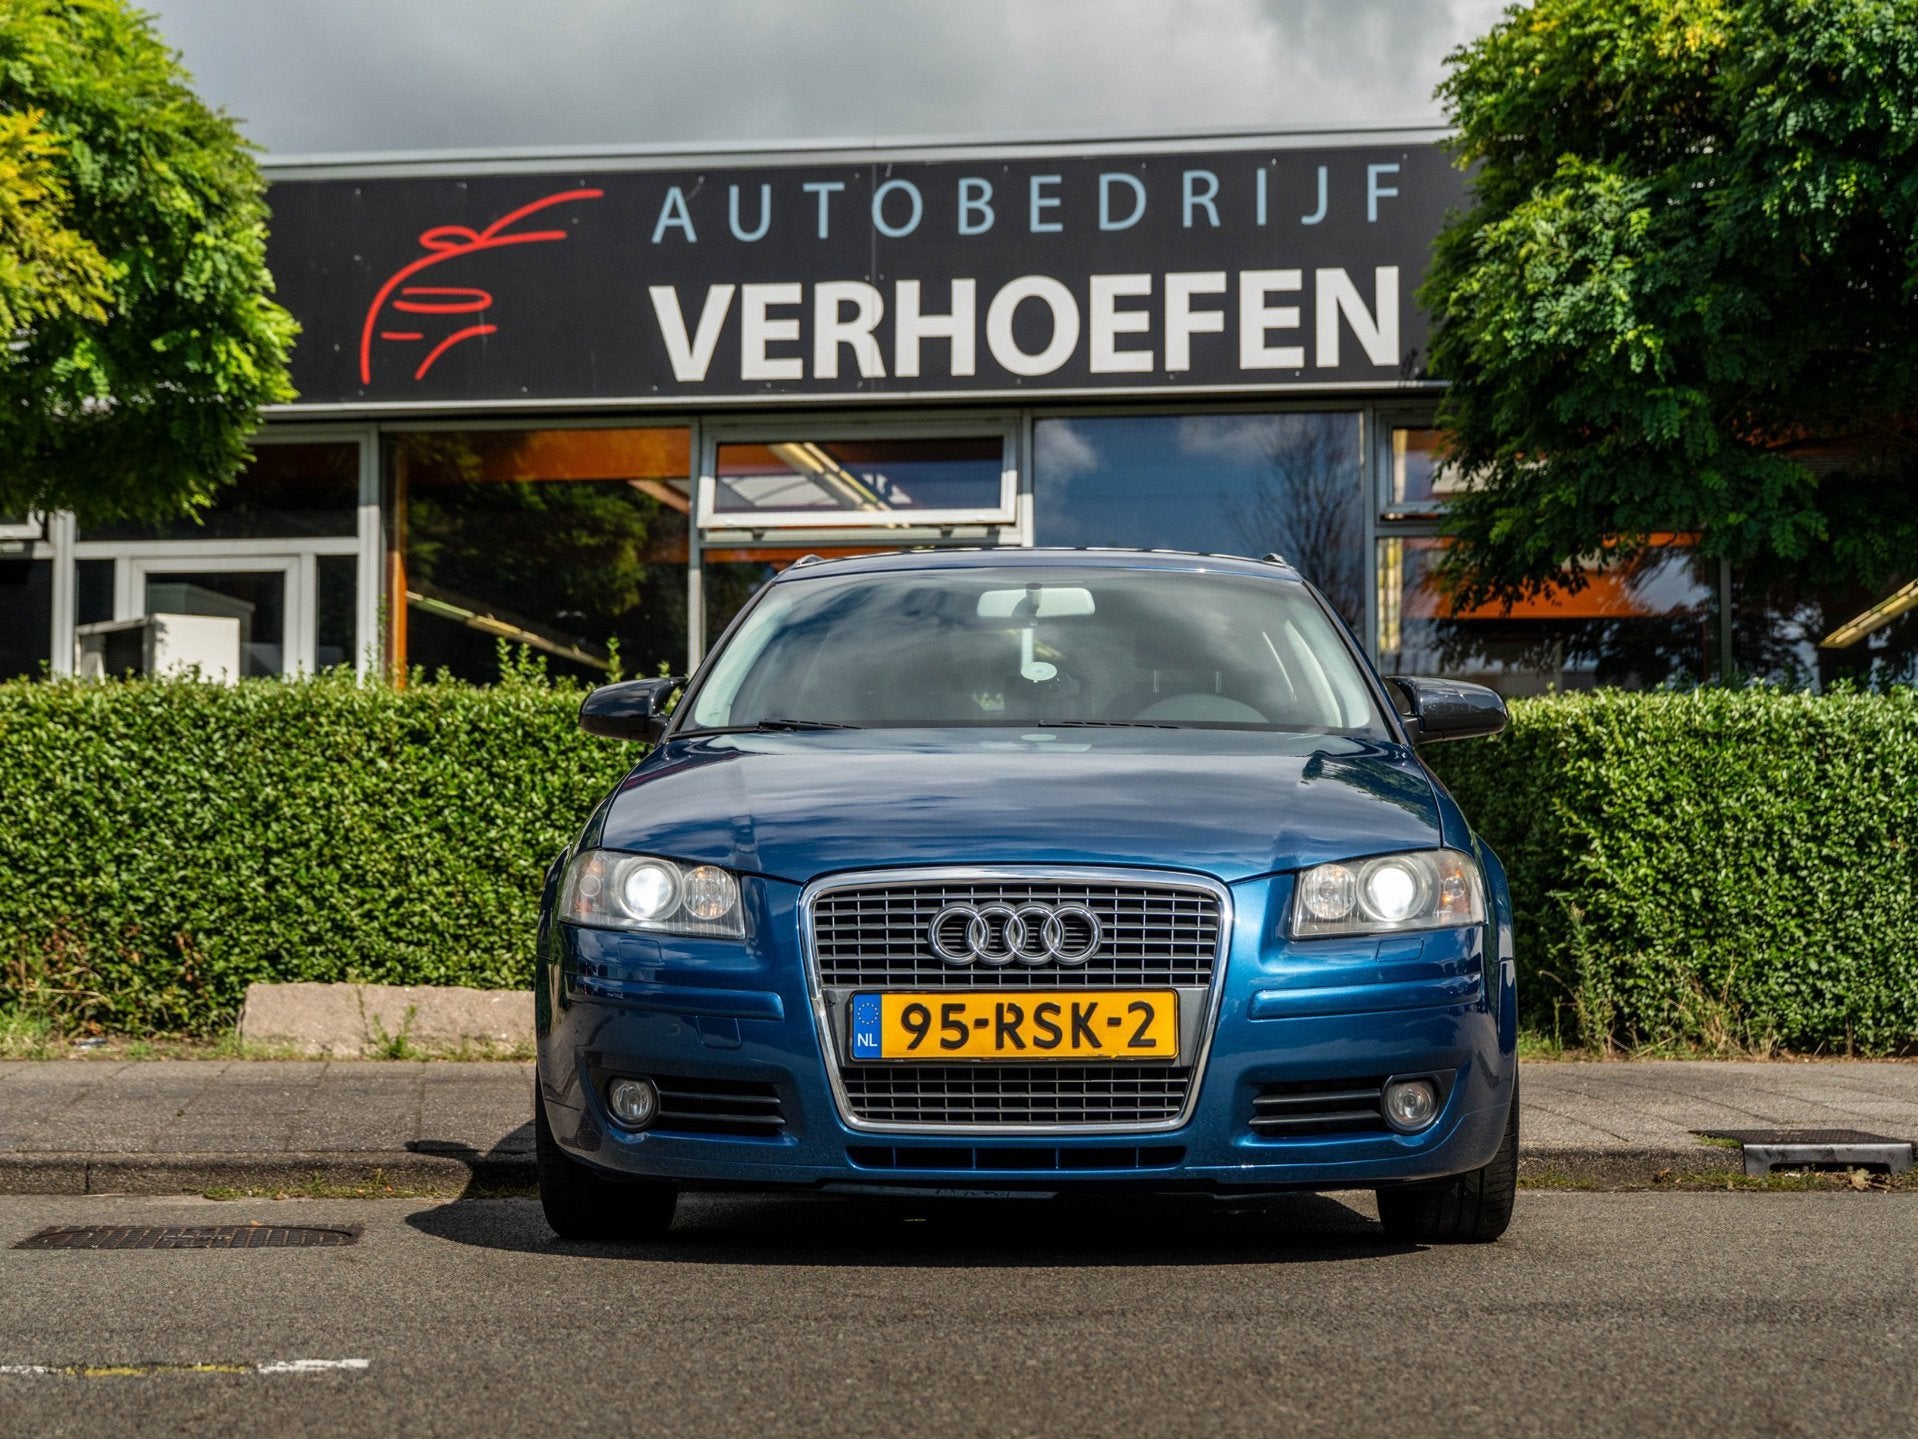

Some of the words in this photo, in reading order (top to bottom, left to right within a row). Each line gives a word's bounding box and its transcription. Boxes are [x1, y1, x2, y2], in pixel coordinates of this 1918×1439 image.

[652, 163, 1400, 244] AUTOBEDRIJF
[648, 265, 1400, 383] VERHOEFEN
[857, 1033, 878, 1047] NL
[901, 1001, 1158, 1050] 95-RSK-2
